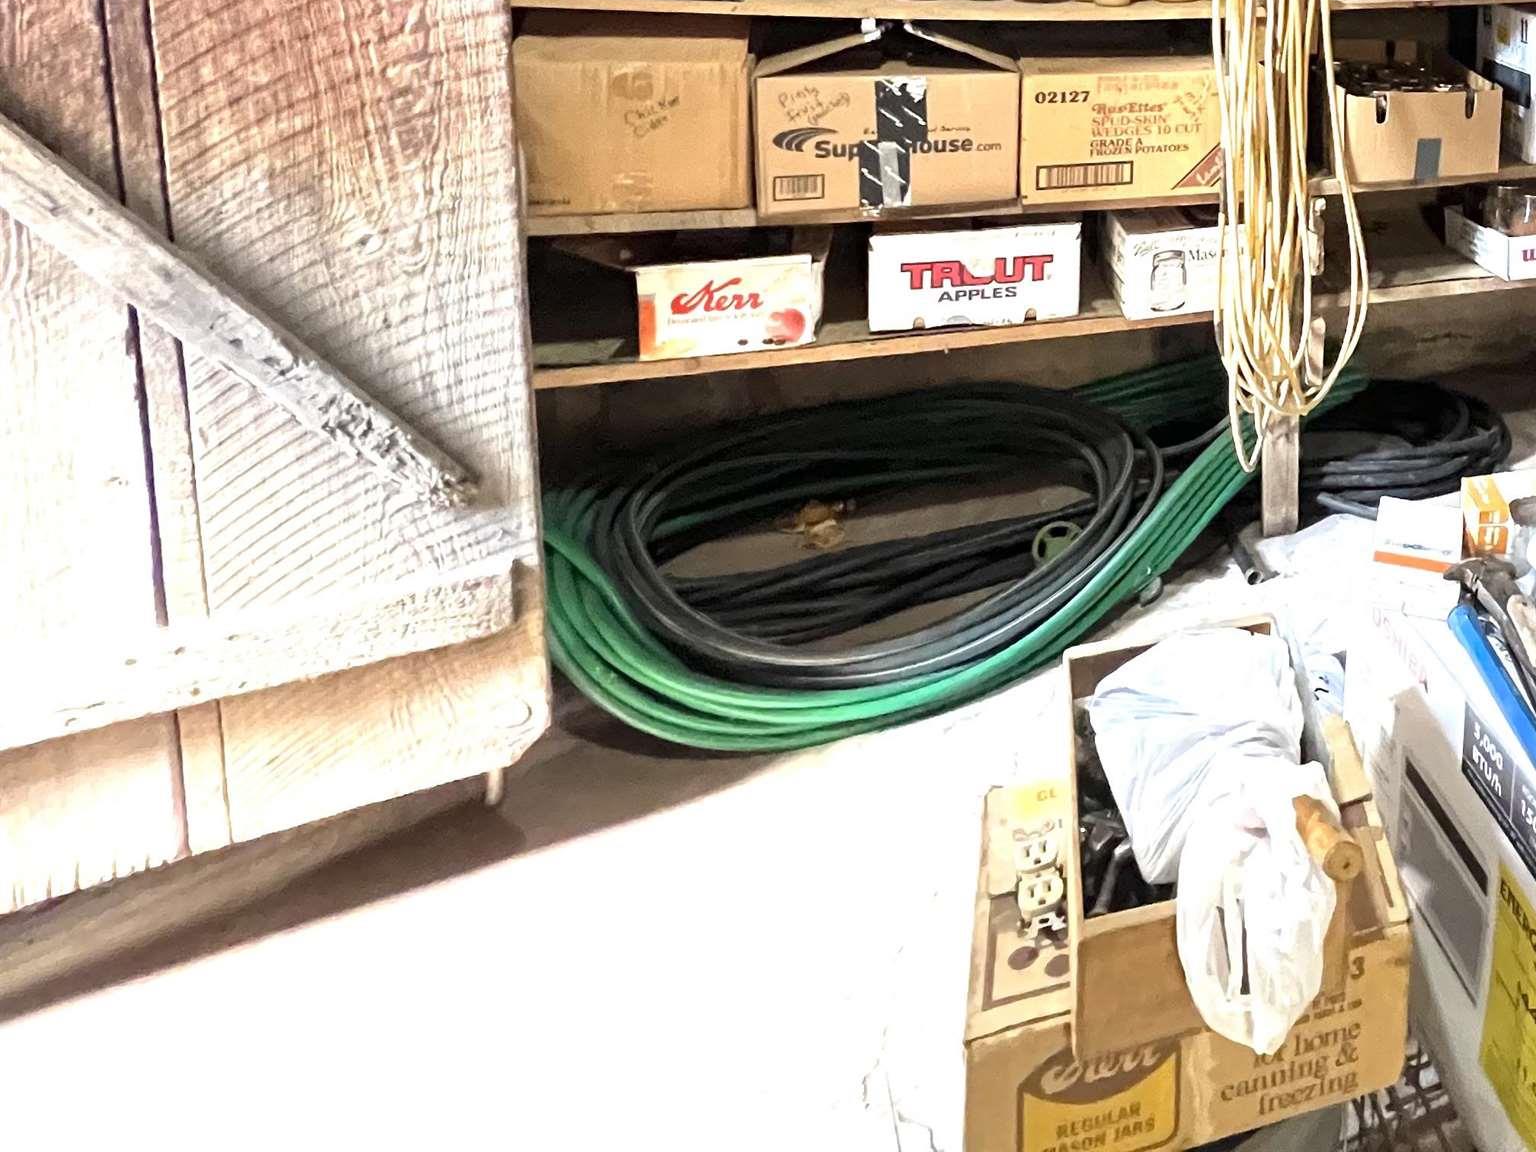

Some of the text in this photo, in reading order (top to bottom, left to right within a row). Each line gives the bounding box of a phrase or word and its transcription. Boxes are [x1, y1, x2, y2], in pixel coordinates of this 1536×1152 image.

[1034, 90, 1090, 104] 02127
[1089, 138, 1144, 149] GRADE A
[1091, 126, 1151, 138] WEDGES
[1174, 123, 1202, 134] CUT
[1089, 144, 1190, 157] FROZEN POTATOES
[670, 277, 764, 315] Kerr
[938, 286, 1018, 303] APPLES
[1294, 1022, 1361, 1057] home
[1220, 1041, 1359, 1101] canning &
[1258, 1071, 1359, 1116] freezing
[1043, 1116, 1156, 1152] ASON JARS
[1056, 1101, 1142, 1140] REGULAR
